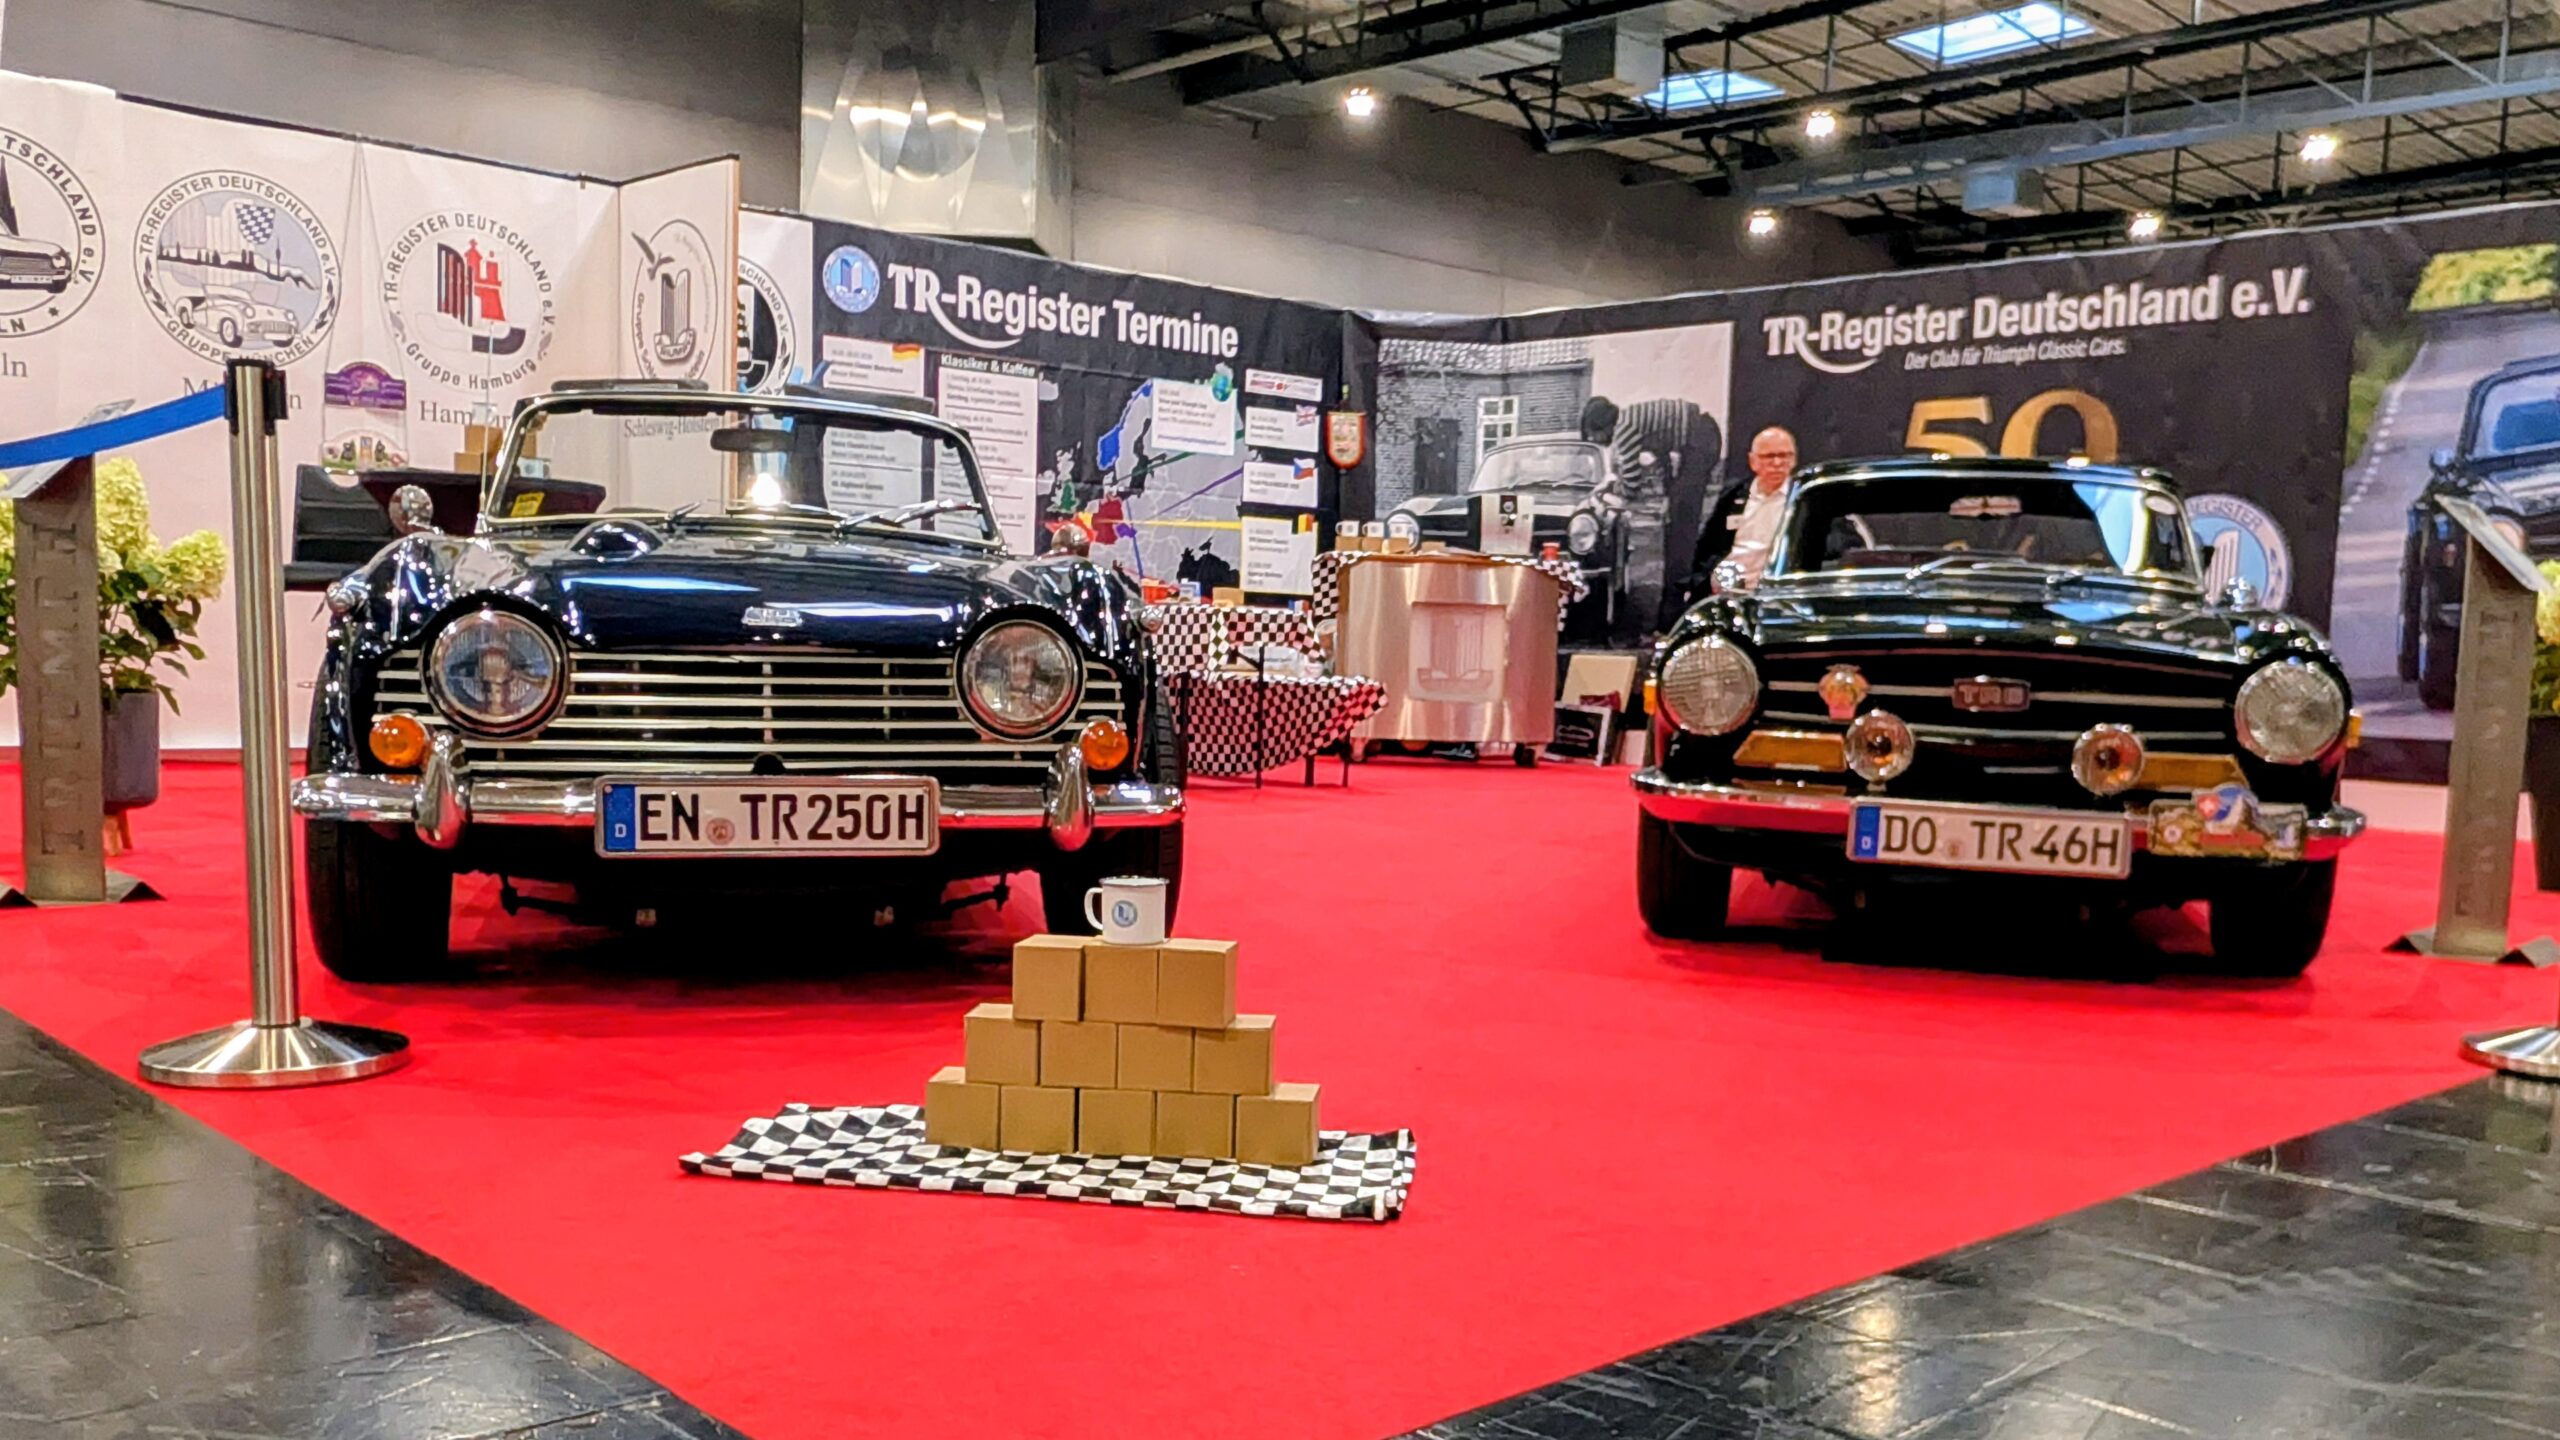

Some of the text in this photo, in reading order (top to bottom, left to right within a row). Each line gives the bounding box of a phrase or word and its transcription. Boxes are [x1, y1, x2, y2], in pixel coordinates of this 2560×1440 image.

[4, 135, 96, 236] TSCHLAND
[140, 177, 213, 254] TR-REGISTER
[219, 175, 327, 249] DEUTSCHLAND
[384, 214, 449, 302] TR-REGISTER
[455, 213, 552, 293] DEUTSCHLAND
[739, 263, 782, 311] SCHLAND
[887, 262, 1106, 349] TR-Register
[1113, 299, 1239, 358] Termine
[167, 320, 233, 362] GRUPPE
[1763, 265, 2314, 374] TR-Register Deutschland e.V.
[406, 343, 537, 390] Gruppe Hamburg
[940, 353, 1036, 377] Klassiker & Kaffee
[1904, 351, 1929, 370] Der
[1929, 348, 1961, 369] Club
[1982, 342, 2037, 366] Triumph
[2037, 338, 2088, 360] Classic
[1904, 389, 2120, 463] 50
[614, 823, 627, 838] D
[639, 793, 700, 841] EN
[1882, 814, 1937, 856] DO
